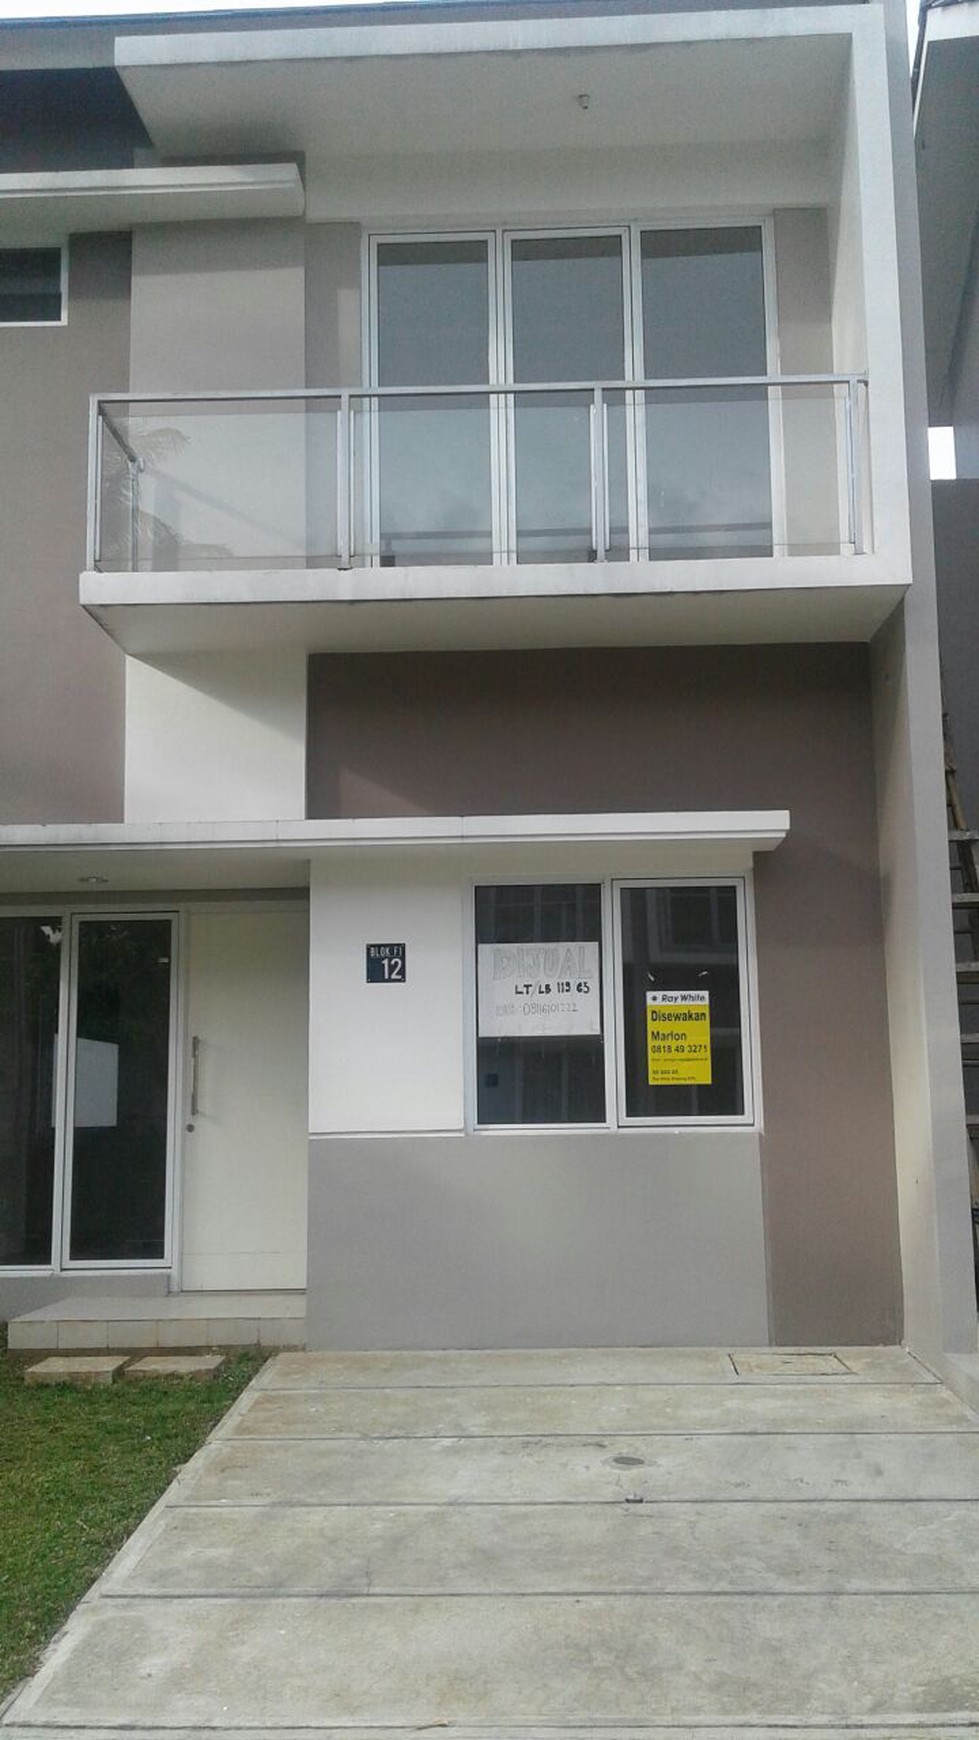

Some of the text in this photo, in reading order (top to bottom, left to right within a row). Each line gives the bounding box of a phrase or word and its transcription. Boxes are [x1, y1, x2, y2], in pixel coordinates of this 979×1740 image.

[370, 946, 391, 957] BLOK
[381, 957, 402, 979] 12
[493, 945, 593, 980] DIJUAL
[661, 993, 706, 1003] Ray White
[651, 1010, 707, 1022] Disewakan
[651, 1044, 672, 1053] 0818
[674, 1044, 685, 1053] 49
